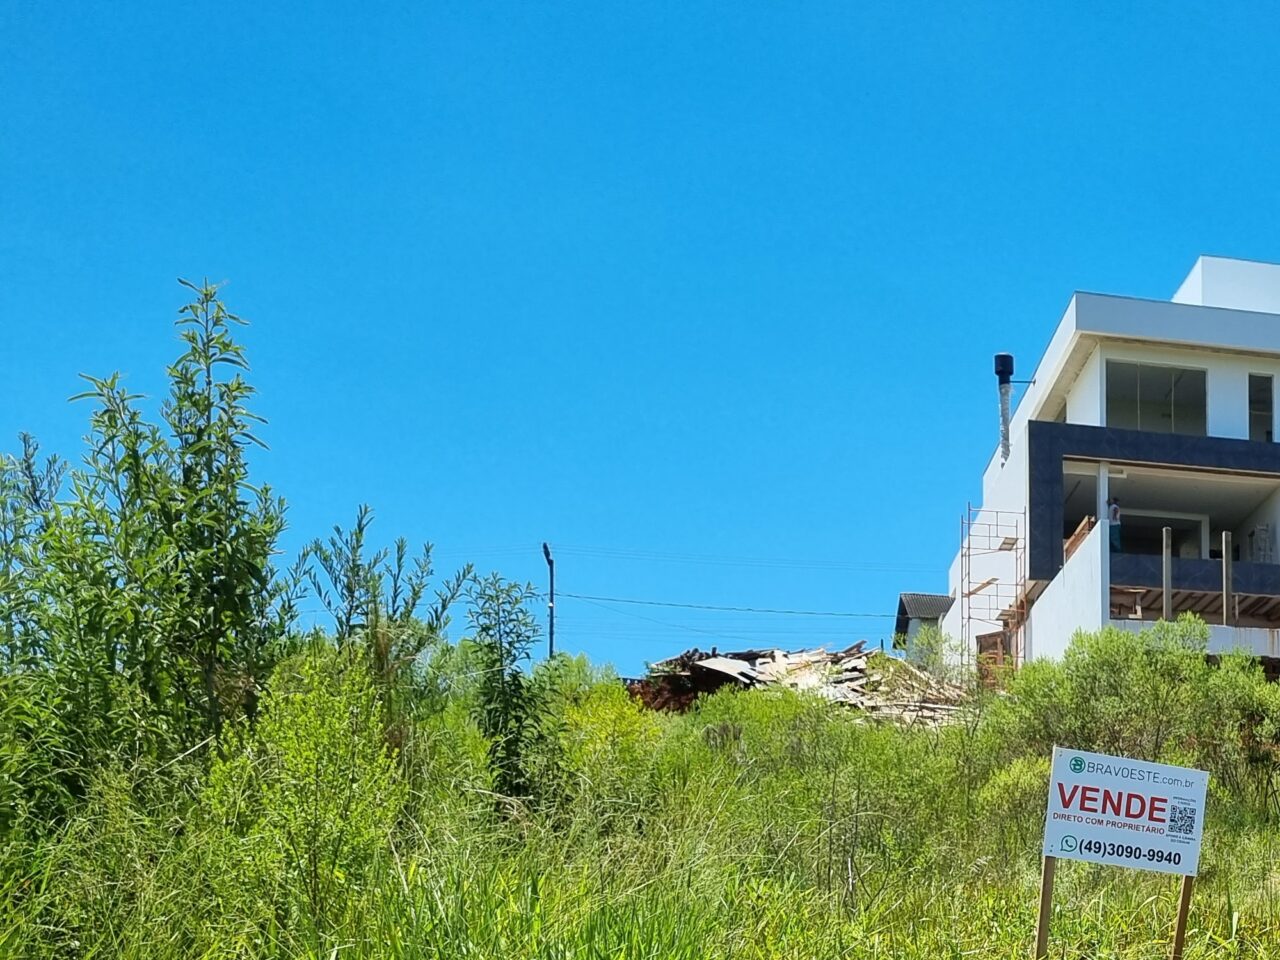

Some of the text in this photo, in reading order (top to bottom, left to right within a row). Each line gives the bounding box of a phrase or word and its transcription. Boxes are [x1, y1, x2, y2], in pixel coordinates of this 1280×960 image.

[1087, 762, 1194, 788] BRAVOESTE.com.br
[1057, 782, 1168, 823] VENDE
[1053, 812, 1165, 835] DIRETO COM PROPRIETÁRIO
[1079, 839, 1181, 865] (49)3090-9940
